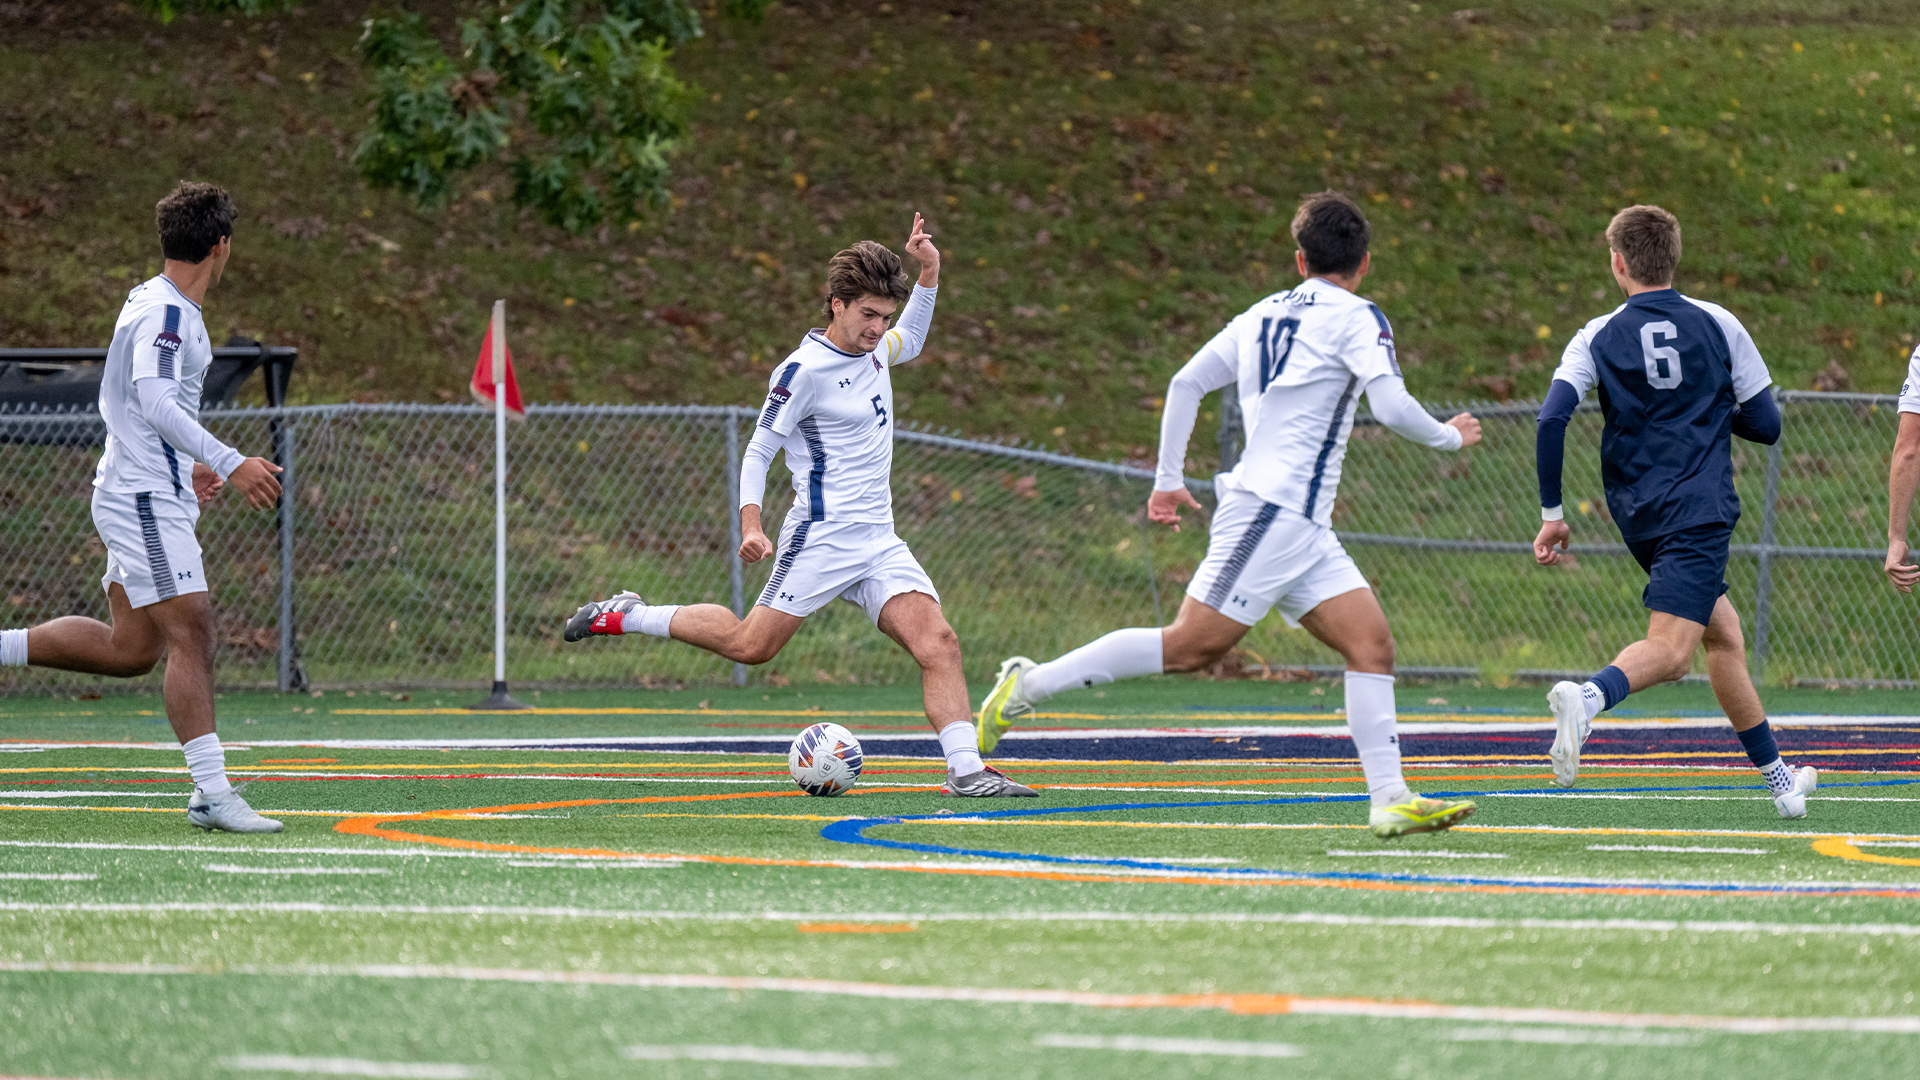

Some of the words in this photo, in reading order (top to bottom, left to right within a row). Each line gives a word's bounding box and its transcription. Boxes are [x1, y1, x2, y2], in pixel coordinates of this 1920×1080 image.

[155, 338, 179, 351] MAC
[1640, 320, 1683, 390] 6
[769, 391, 788, 403] MAC
[871, 394, 888, 428] 5
